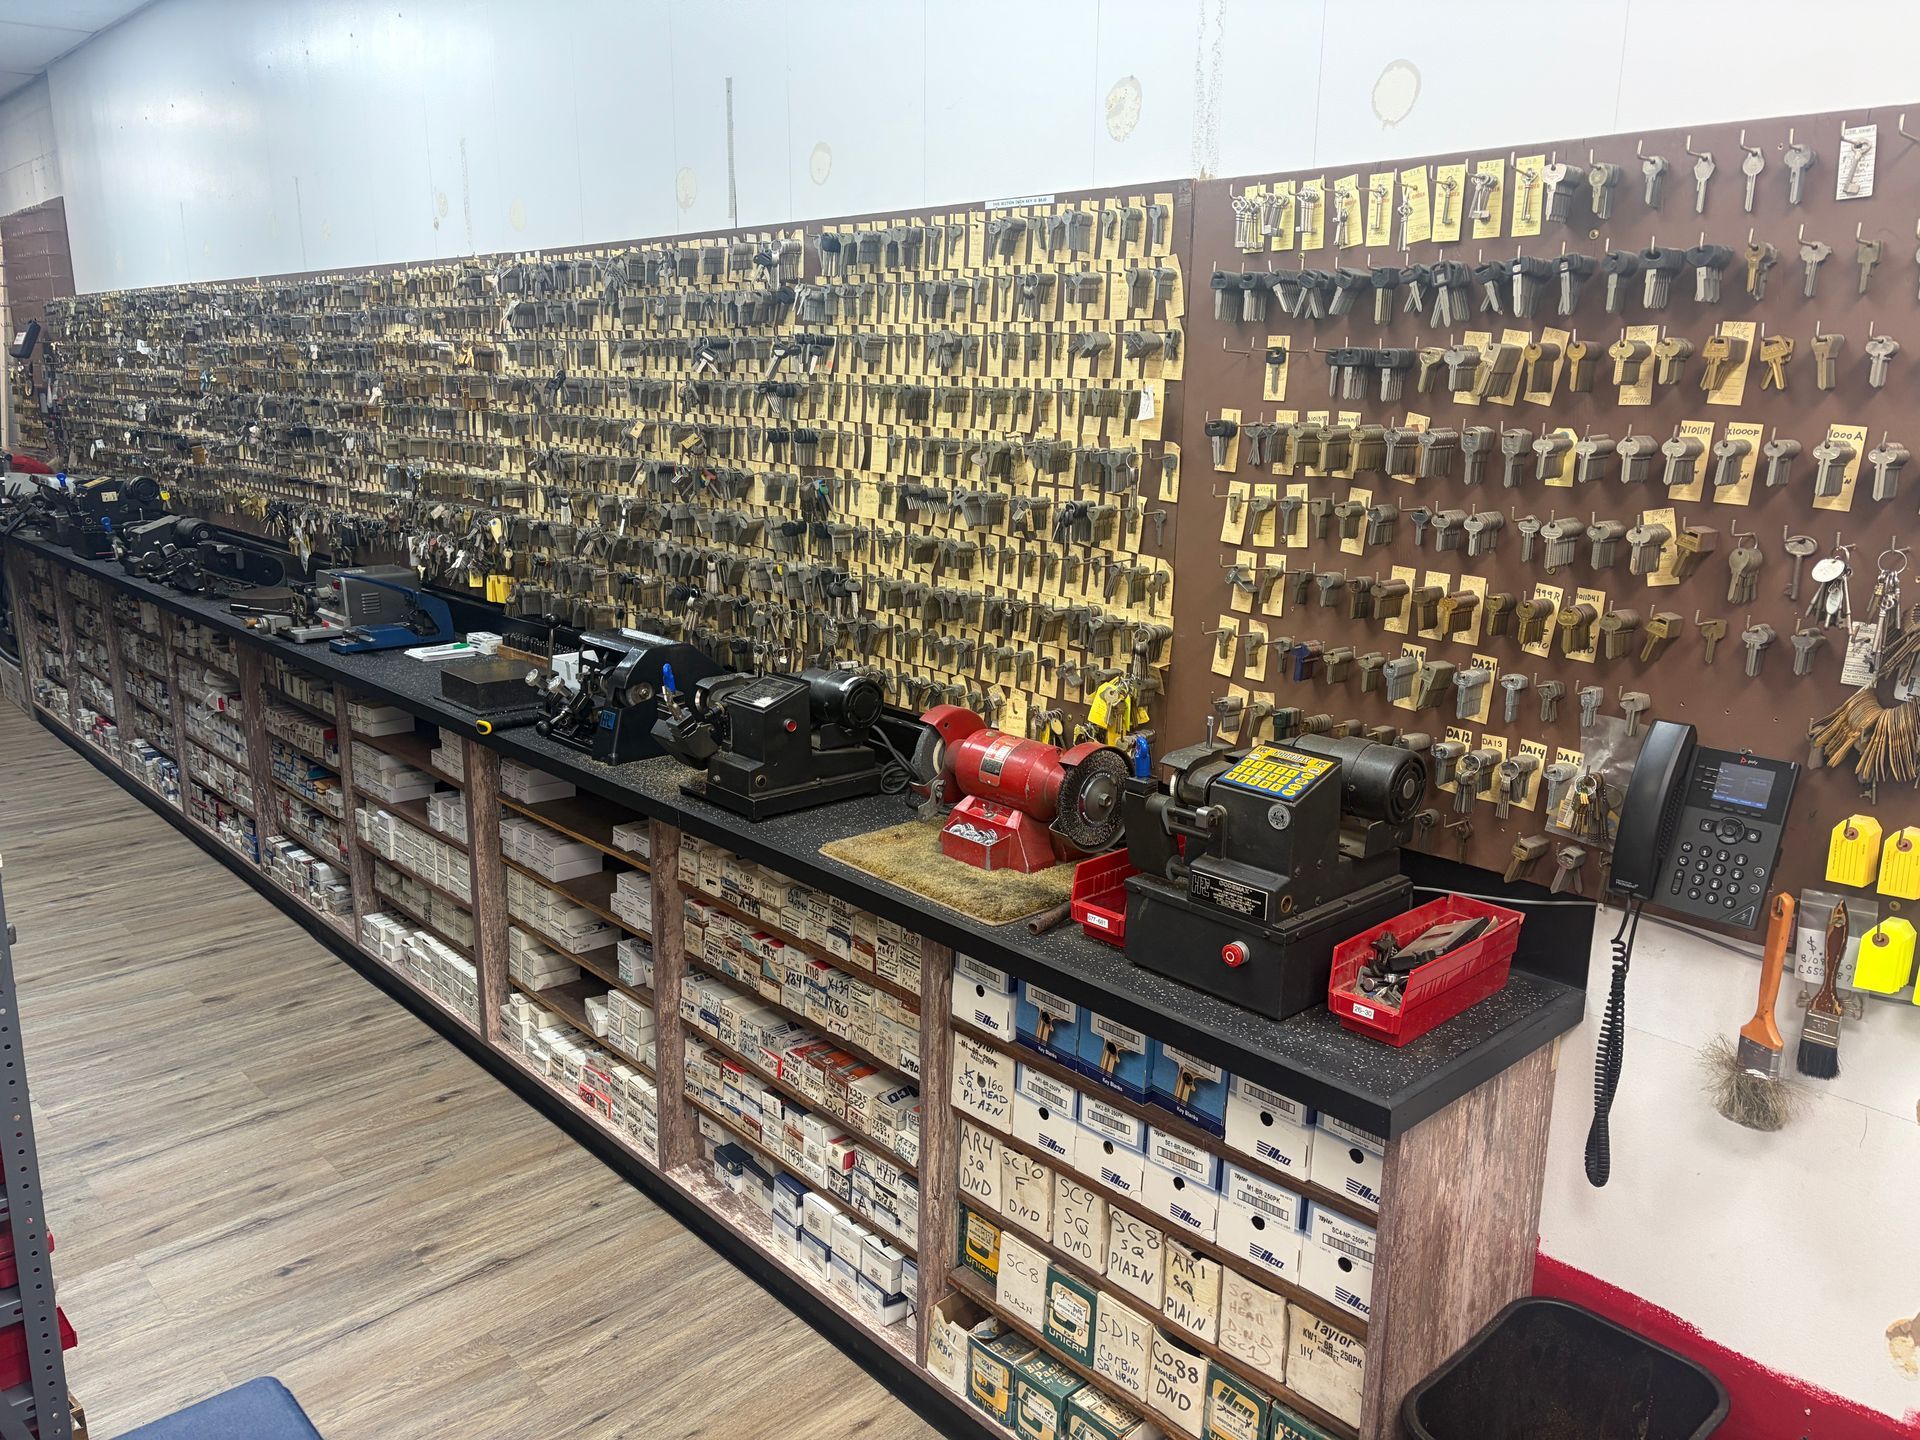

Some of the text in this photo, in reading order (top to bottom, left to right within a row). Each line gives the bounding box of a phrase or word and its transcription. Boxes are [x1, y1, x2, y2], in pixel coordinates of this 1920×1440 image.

[1401, 647, 1425, 661] DA19
[1471, 658, 1496, 671] DA21
[1482, 737, 1503, 748] DA13
[1520, 743, 1545, 759] DA14
[977, 1011, 999, 1031] ilco
[962, 1089, 1004, 1116] PLAIN
[961, 1124, 994, 1161] AR4
[1041, 1134, 1066, 1156] ilco
[1259, 1141, 1292, 1167] ilco
[1002, 1152, 1044, 1180] SC10
[961, 1167, 993, 1197] DND
[1015, 1176, 1030, 1191] F
[1103, 1168, 1131, 1191] ilco
[1060, 1178, 1095, 1214] SC9
[1009, 1199, 1041, 1223] DND
[1063, 1207, 1090, 1240] SQ
[1173, 1204, 1202, 1228] ilco
[1110, 1210, 1160, 1251] SC8
[1063, 1231, 1093, 1259] DND
[1120, 1239, 1145, 1260] SQ
[1252, 1244, 1285, 1270] ilco
[1006, 1252, 1040, 1284] SC8
[1003, 1290, 1033, 1316] PLAIN
[1302, 1327, 1364, 1369] KW1-BR-250PK
[1024, 1360, 1045, 1374] Bin
[1034, 1363, 1061, 1380] Pack
[1156, 1377, 1192, 1412] DND
